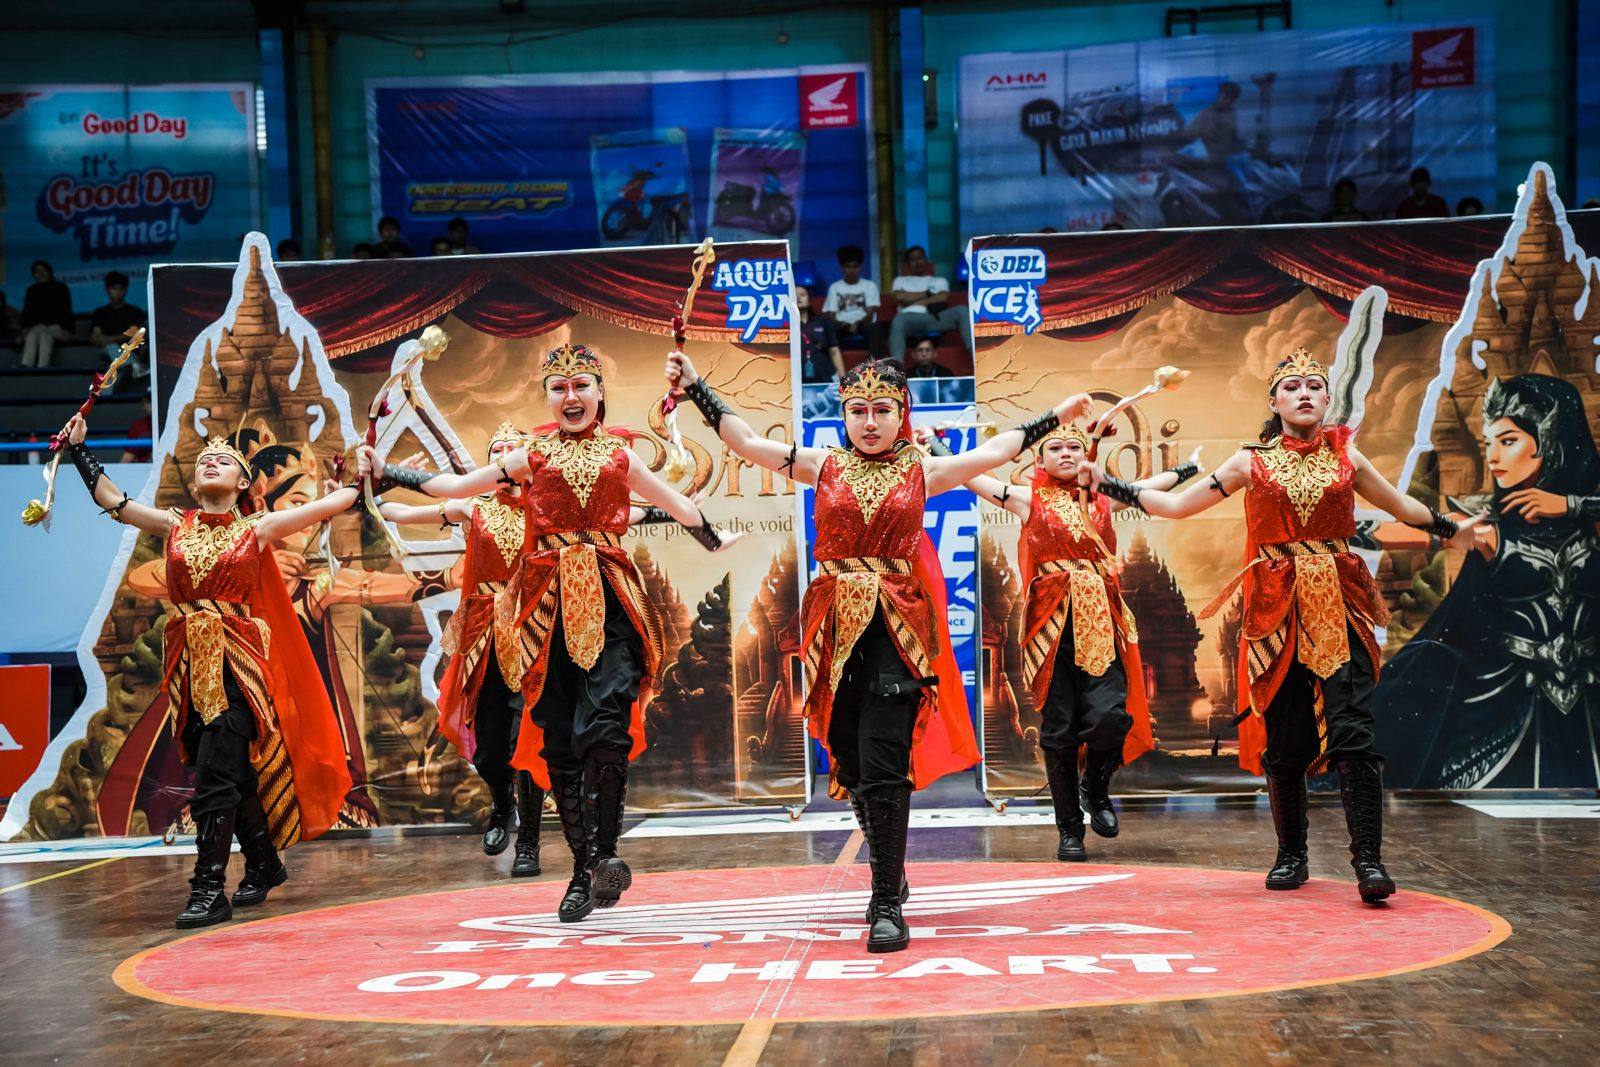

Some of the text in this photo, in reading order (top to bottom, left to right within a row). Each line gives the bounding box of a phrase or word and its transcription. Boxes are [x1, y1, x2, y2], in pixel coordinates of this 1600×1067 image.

[987, 72, 1047, 86] AHM
[83, 112, 139, 135] Good
[143, 111, 187, 140] Day
[81, 152, 117, 178] It's
[48, 168, 213, 217] Good Day
[83, 207, 180, 250] Time!
[714, 261, 790, 291] AQUA
[1001, 255, 1043, 274] DBL
[729, 517, 754, 534] the
[759, 514, 793, 533] void
[413, 922, 1193, 954] HONDA
[357, 953, 1218, 993] One HEART.
